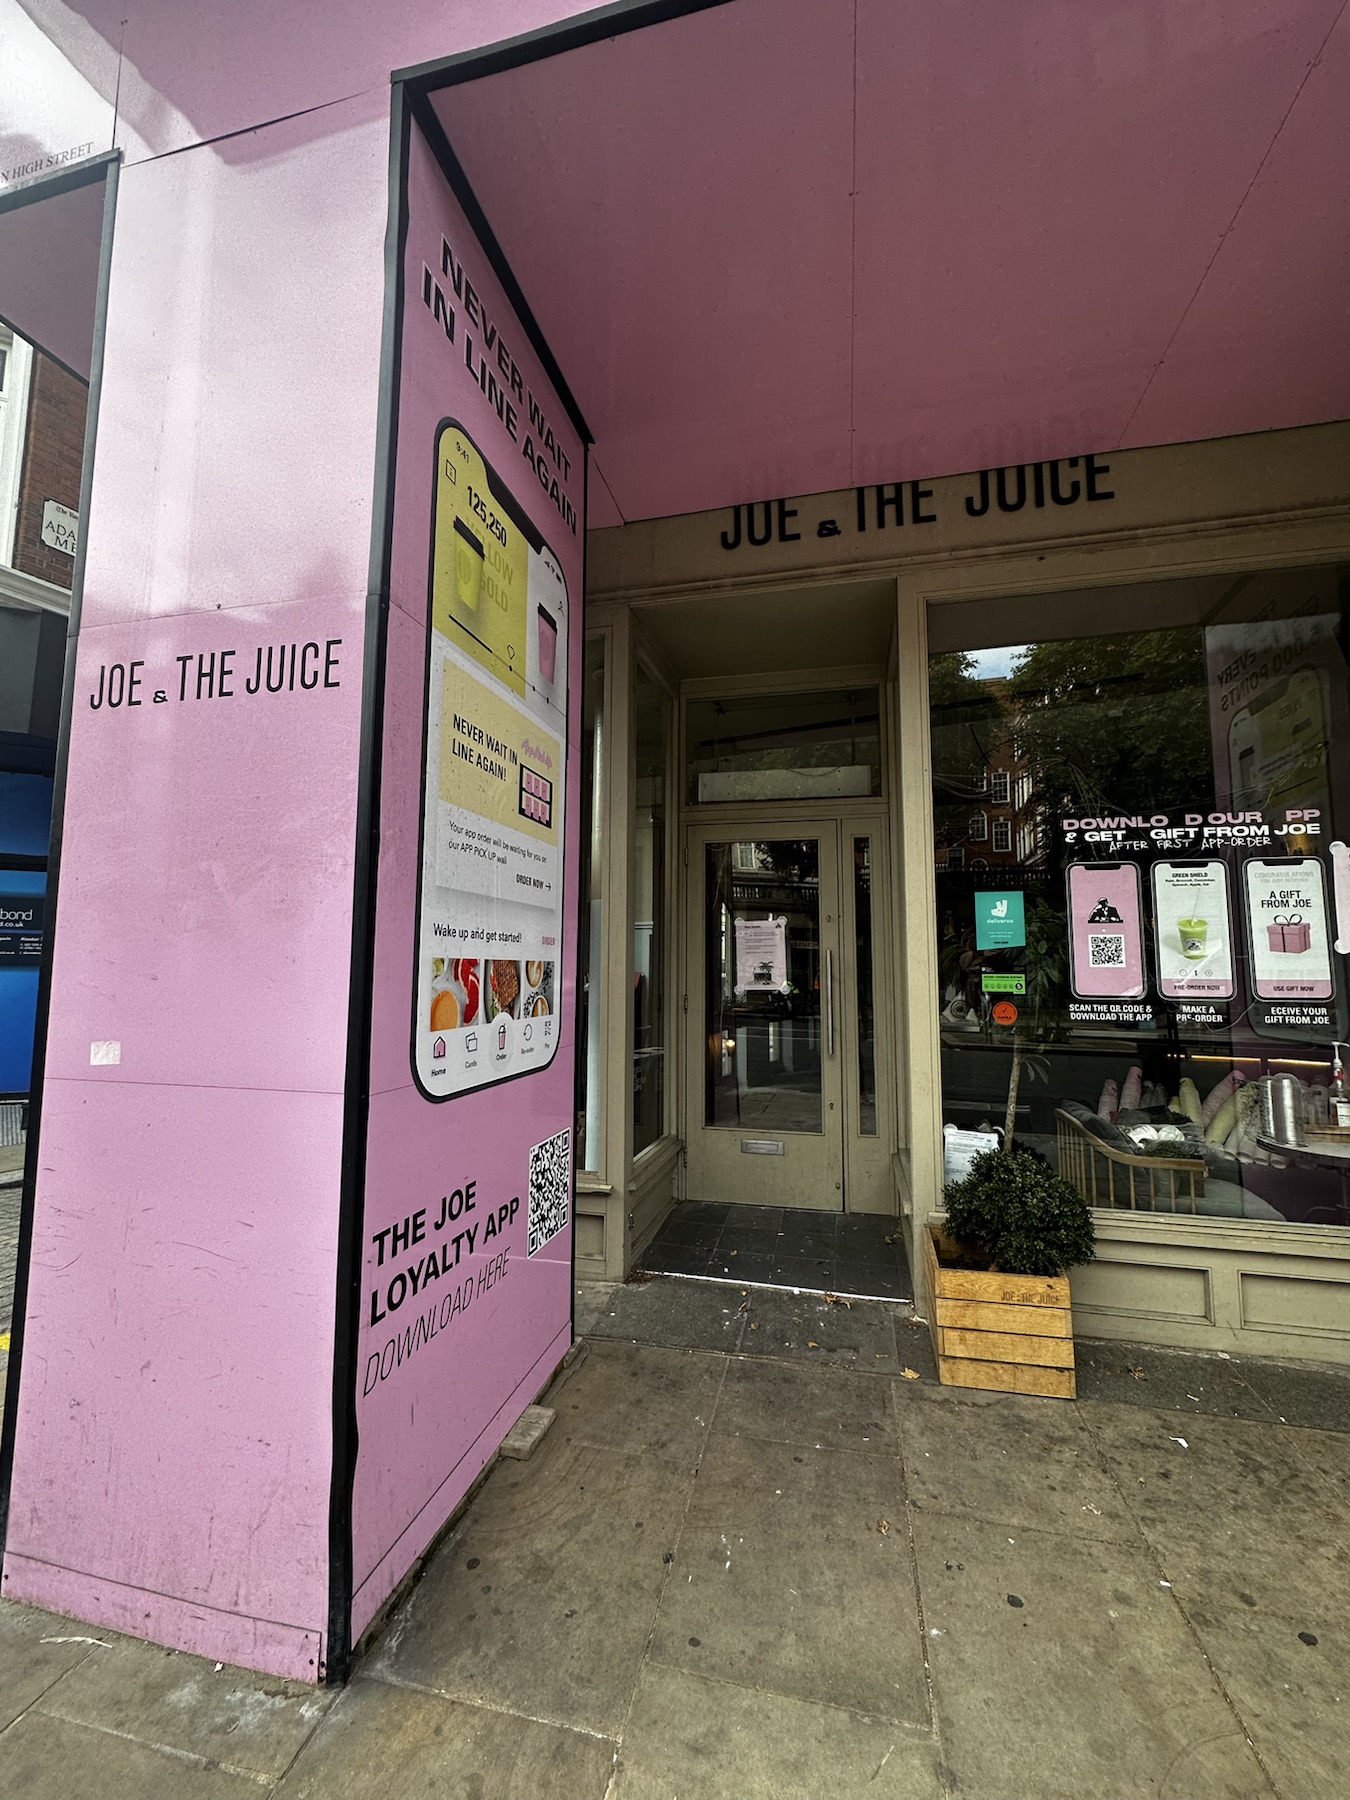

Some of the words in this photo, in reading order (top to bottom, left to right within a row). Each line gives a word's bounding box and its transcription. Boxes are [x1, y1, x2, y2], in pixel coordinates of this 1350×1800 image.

[13, 159, 43, 178] HIGH
[46, 142, 94, 167] STREET
[441, 232, 524, 406] NEVER
[528, 385, 572, 483] WAIT
[422, 260, 455, 345] IN
[464, 329, 518, 443] LINE
[521, 431, 577, 536] AGAIN
[456, 441, 470, 464] 9:41
[817, 518, 842, 538] &
[965, 454, 1115, 517] JUICE
[467, 486, 507, 547] 125,250
[90, 660, 145, 710] JOE
[153, 690, 168, 704] &
[176, 650, 236, 701] THE
[246, 639, 342, 695] JUICE
[454, 714, 484, 746] NEVER
[486, 733, 508, 760] WAIT
[510, 748, 518, 765] IN
[452, 738, 474, 764] LINE
[476, 753, 507, 781] AGAIN!
[1208, 811, 1262, 824] OUR
[1285, 809, 1321, 822] PP
[449, 821, 464, 834] Your
[466, 828, 476, 840] app
[477, 832, 492, 844] order
[493, 836, 501, 847] will
[503, 840, 509, 850] be
[510, 843, 526, 858] waiting
[1064, 832, 1077, 843] &
[1084, 830, 1126, 842] GET
[1150, 827, 1199, 840] GIFT
[1203, 825, 1269, 837] FROM
[1274, 823, 1320, 835] JOE
[448, 841, 460, 851] our
[461, 843, 473, 856] APP
[474, 846, 487, 859] PICK
[488, 850, 496, 861] UP
[1109, 841, 1149, 853] AFTER
[1201, 837, 1272, 850] APP-ORDER
[516, 874, 532, 887] ORDER
[532, 879, 544, 890] NOW
[1261, 900, 1290, 908] FROM
[1292, 899, 1312, 908] JOE
[1270, 891, 1276, 899] A
[1280, 890, 1301, 899] GIFT
[434, 923, 456, 938] Wake
[458, 928, 468, 940] up
[470, 928, 484, 940] and
[486, 931, 497, 942] get
[498, 932, 522, 943] started!
[542, 936, 555, 946] ORDER
[1122, 1004, 1144, 1013] CODE
[1182, 1005, 1207, 1013] MAKE
[1209, 1006, 1216, 1014] A
[1271, 1007, 1301, 1015] ECEIVE
[1302, 1007, 1327, 1015] YOUR
[1265, 1016, 1284, 1024] GIFT
[1312, 1016, 1330, 1024] JOE
[496, 1053, 507, 1061] Order
[521, 1047, 534, 1055] Re-order
[431, 1068, 446, 1077] Home
[465, 1060, 477, 1069] Cards
[372, 1207, 426, 1267] THE
[434, 1180, 477, 1231] JOE
[370, 1221, 480, 1328] LOYALTY
[483, 1196, 520, 1245] APP
[1001, 1291, 1015, 1301] JOE
[363, 1276, 474, 1398] DOWNLOAD
[476, 1246, 511, 1300] HERE
